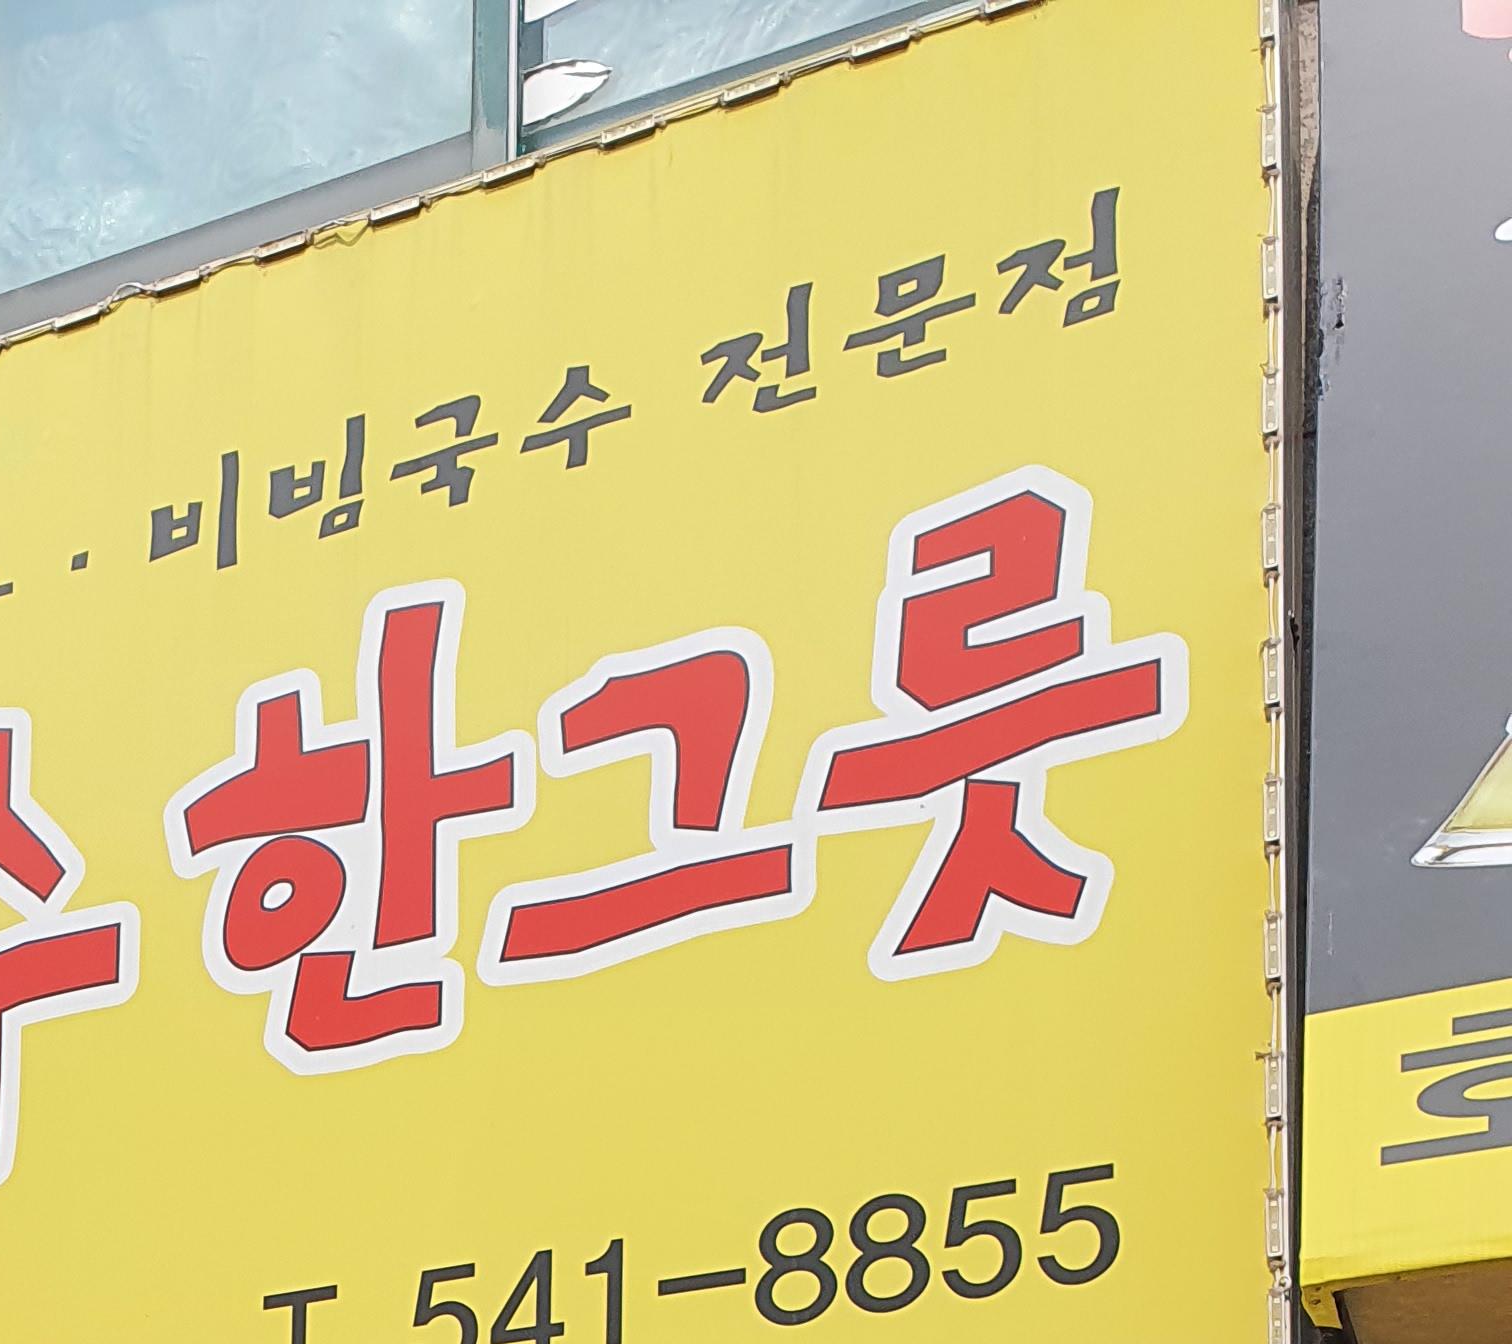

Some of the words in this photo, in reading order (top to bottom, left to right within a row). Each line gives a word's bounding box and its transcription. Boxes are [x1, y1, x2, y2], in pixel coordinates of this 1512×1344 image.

[149, 365, 632, 570] 비빔국수
[700, 187, 1120, 413] 전문점
[184, 490, 1162, 1051] 한그릇
